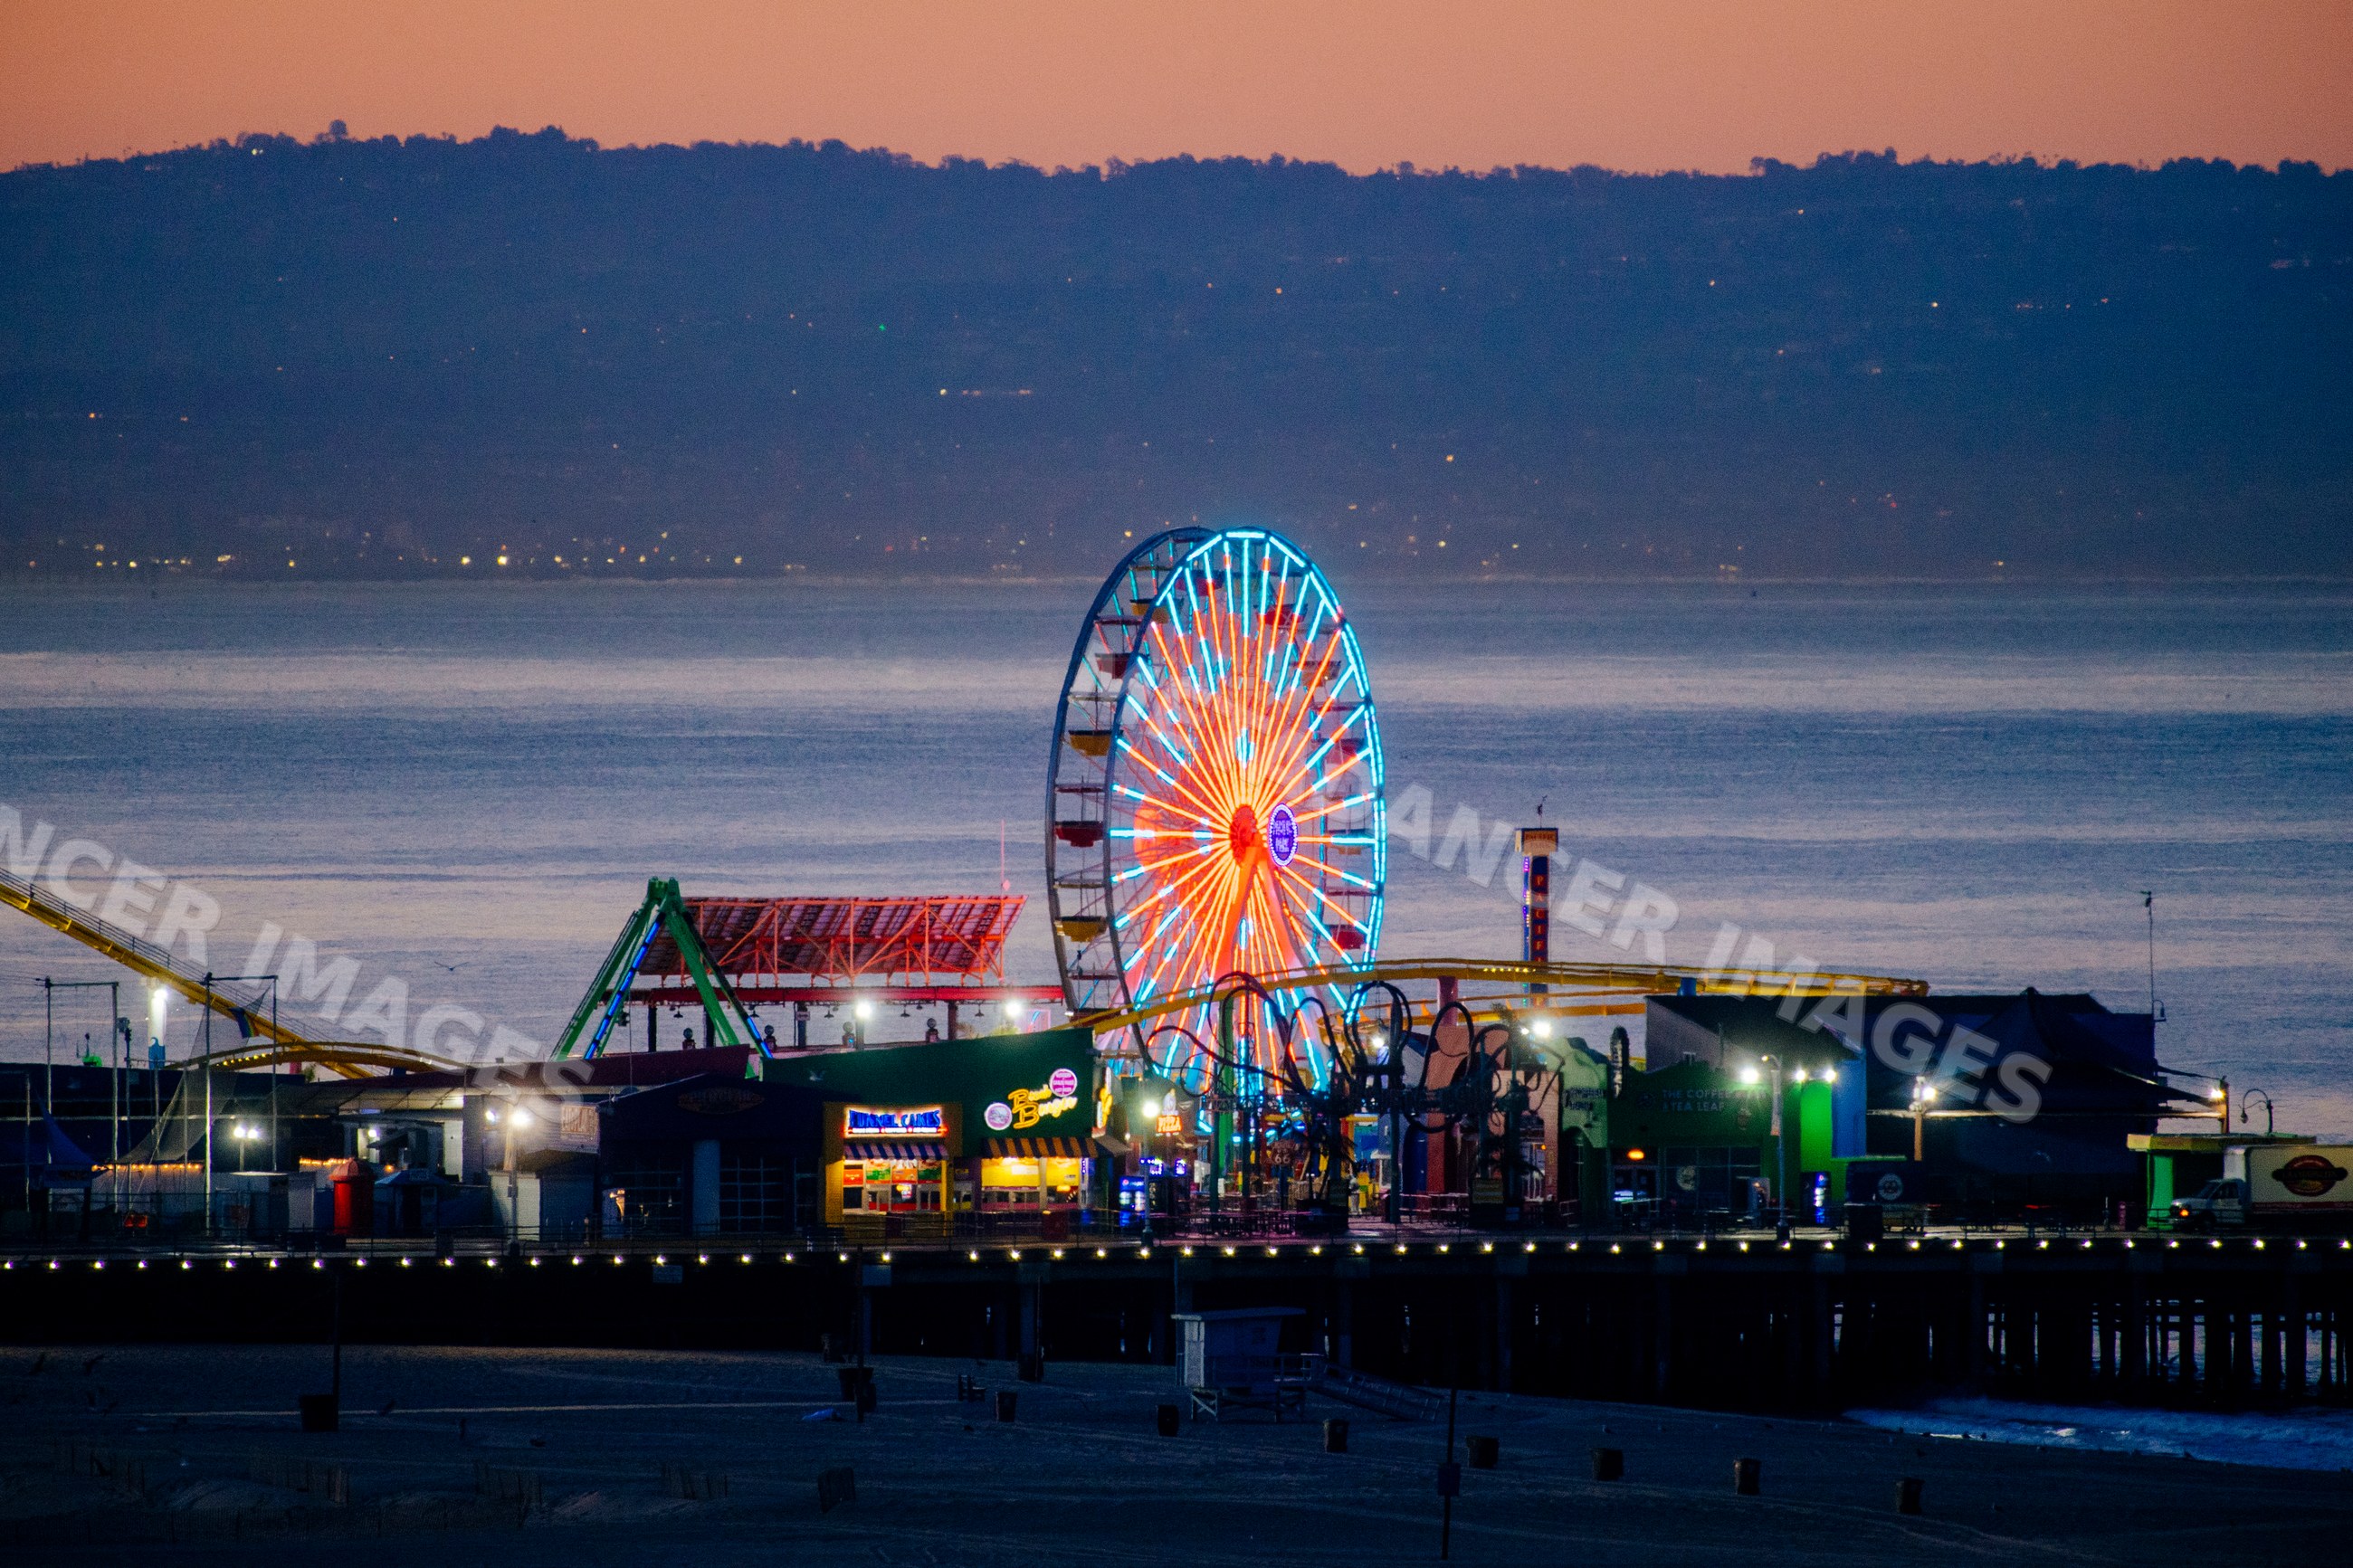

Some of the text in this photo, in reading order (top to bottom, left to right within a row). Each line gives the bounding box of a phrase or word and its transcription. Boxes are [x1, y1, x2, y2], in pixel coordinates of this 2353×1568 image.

[849, 1109, 941, 1127] FUNNEL CAKES
[1157, 1116, 1182, 1133] PIZZA
[1274, 1154, 1291, 1164] 66
